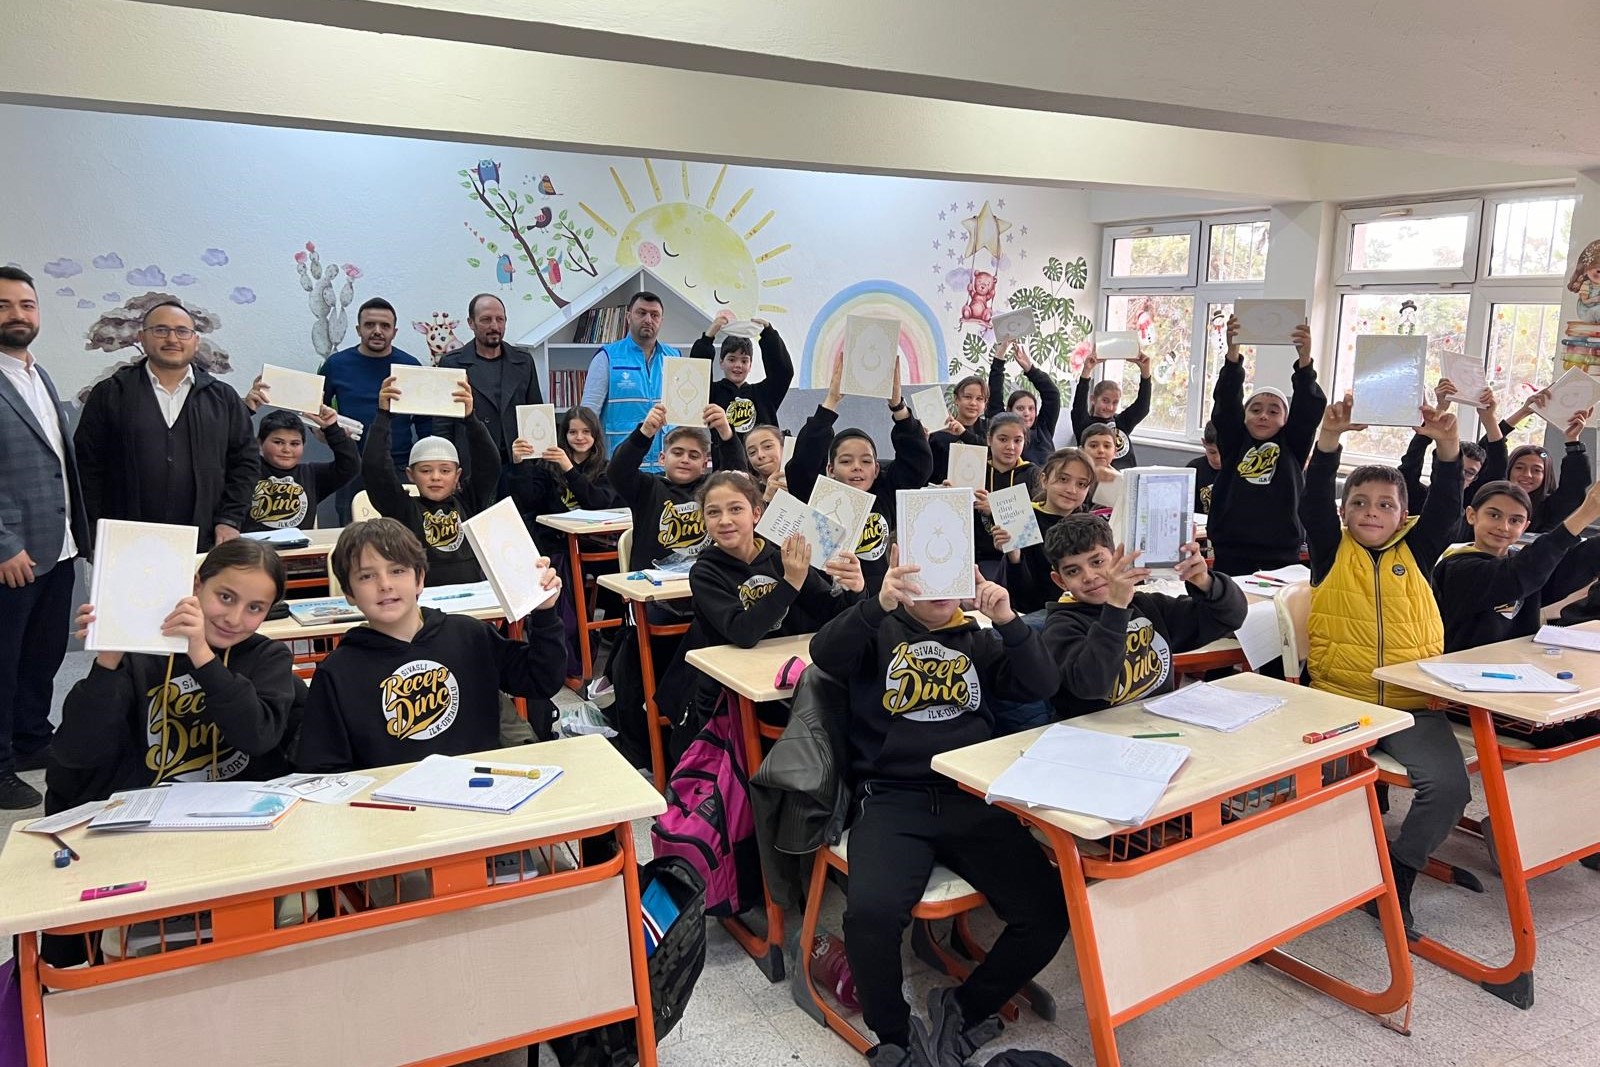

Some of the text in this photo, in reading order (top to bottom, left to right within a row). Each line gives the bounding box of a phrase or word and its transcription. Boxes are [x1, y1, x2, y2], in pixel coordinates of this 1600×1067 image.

[379, 666, 449, 705] Recep
[400, 663, 428, 677] SİVASLI
[891, 641, 970, 688] Recep
[146, 682, 207, 721] Rec
[386, 686, 451, 739] Dinç
[882, 668, 970, 716] Dinç
[145, 718, 225, 774] Din
